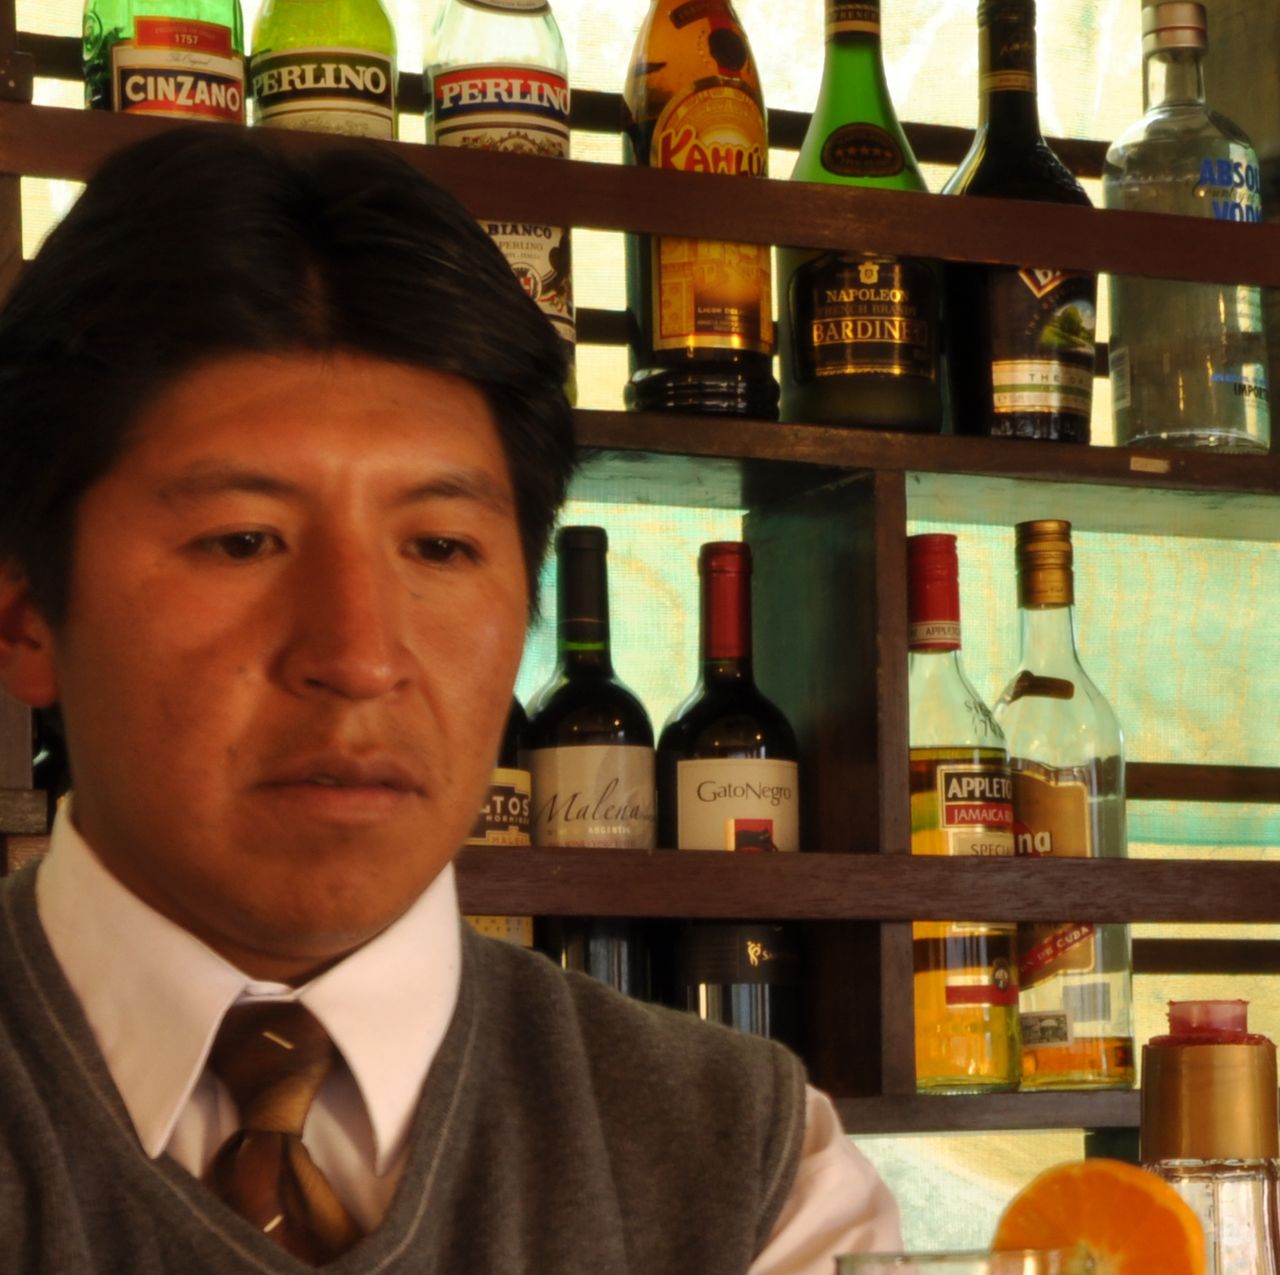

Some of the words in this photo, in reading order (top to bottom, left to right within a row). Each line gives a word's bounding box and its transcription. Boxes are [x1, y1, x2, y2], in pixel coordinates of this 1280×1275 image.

[174, 33, 199, 45] 1757
[125, 75, 240, 112] CINZANO
[252, 63, 387, 101] PERLINO
[440, 77, 570, 116] PERLINO
[658, 124, 766, 178] KAHLÚ
[487, 223, 552, 239] BIANCO
[825, 287, 909, 303] NAPOLEON
[813, 320, 924, 343] BARDINE
[539, 777, 642, 823] Malena
[696, 780, 792, 807] GatoNegro
[954, 808, 1003, 823] JAMAICA
[1055, 925, 1089, 948] CUBA
